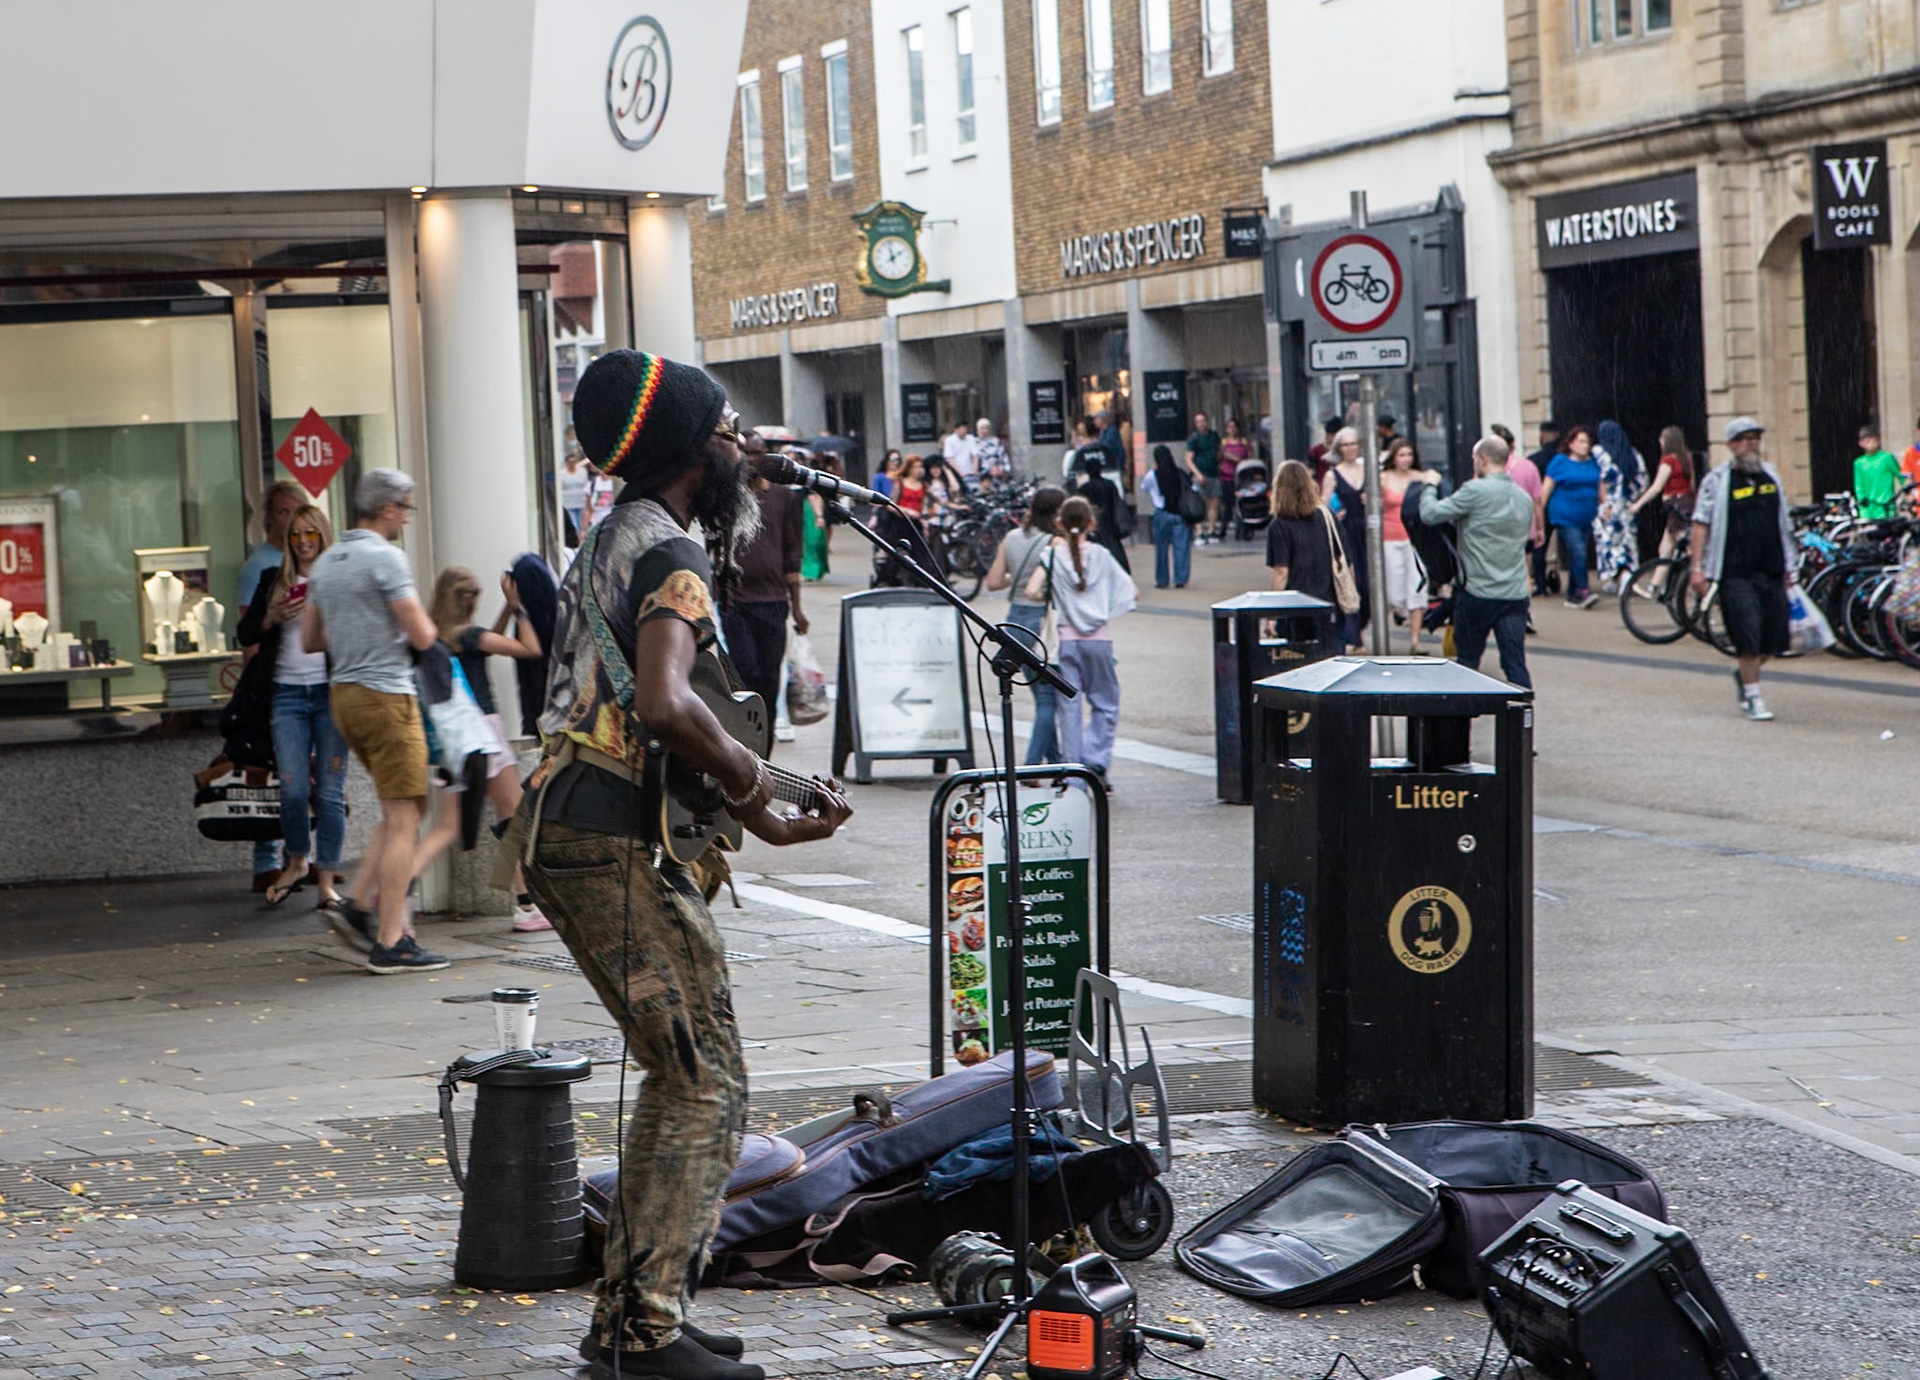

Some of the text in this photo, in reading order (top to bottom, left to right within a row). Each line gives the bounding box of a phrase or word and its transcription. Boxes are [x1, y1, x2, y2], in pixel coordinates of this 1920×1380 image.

[1823, 155, 1880, 199] W
[1827, 203, 1880, 220] BOOKS
[1545, 198, 1677, 248] WATERSTONES
[1378, 348, 1402, 360] pm
[1395, 785, 1469, 809] Litter
[1035, 867, 1075, 881] Coffees
[1409, 888, 1448, 901] LITTER
[1046, 930, 1080, 947] Bagels
[1022, 953, 1056, 968] Salads
[1401, 948, 1462, 970] DOG WASTE
[1026, 976, 1054, 989] Pasta
